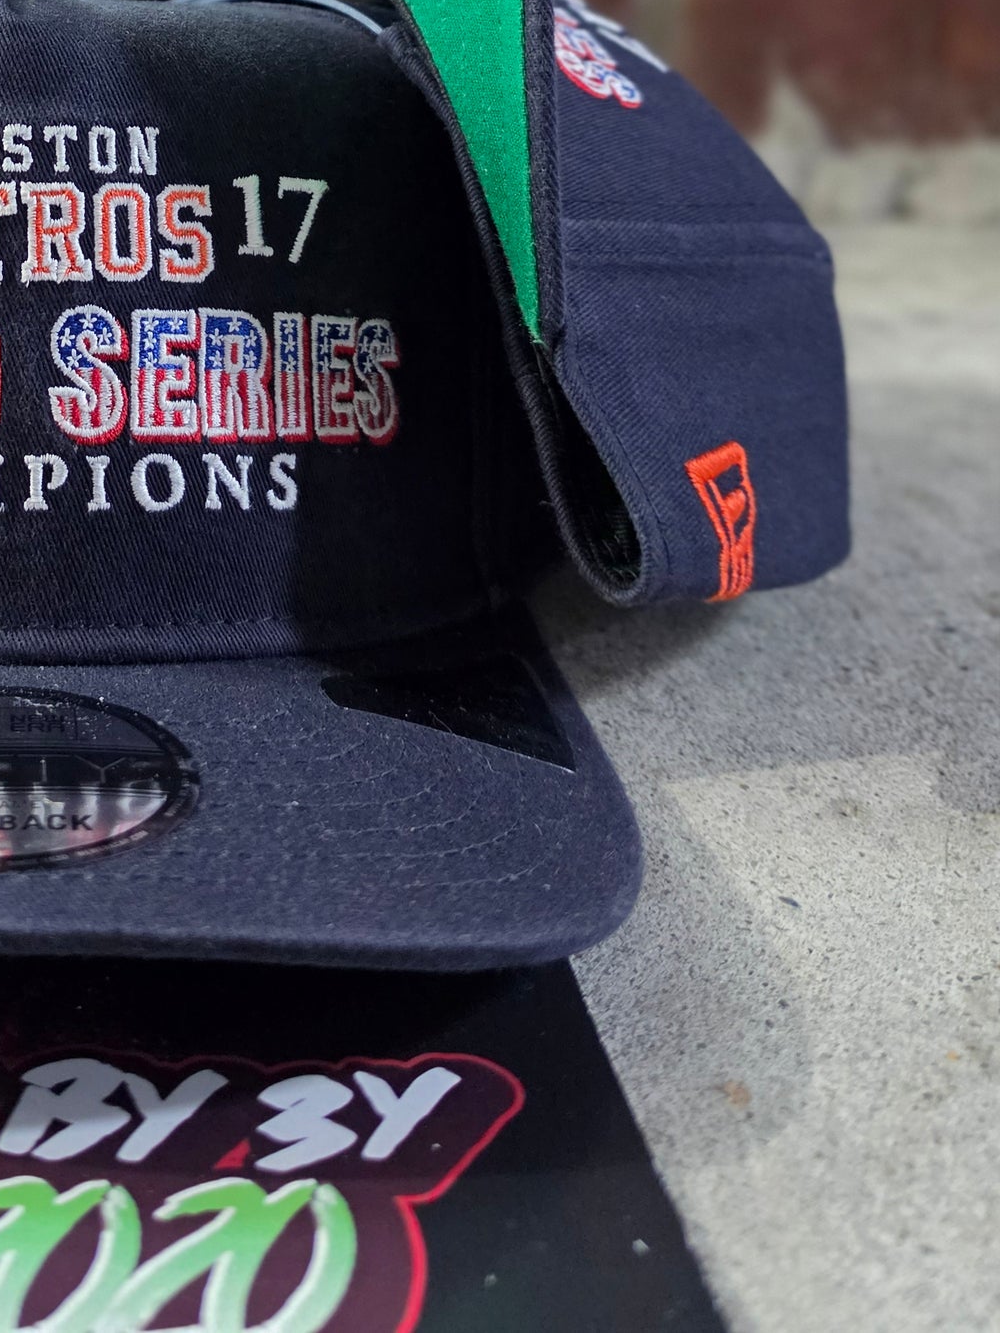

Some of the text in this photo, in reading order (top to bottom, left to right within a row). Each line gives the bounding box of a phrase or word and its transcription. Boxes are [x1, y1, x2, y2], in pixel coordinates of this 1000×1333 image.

[233, 174, 329, 264] 17
[48, 304, 401, 448] SERIES
[253, 1066, 462, 1173] 3Y
